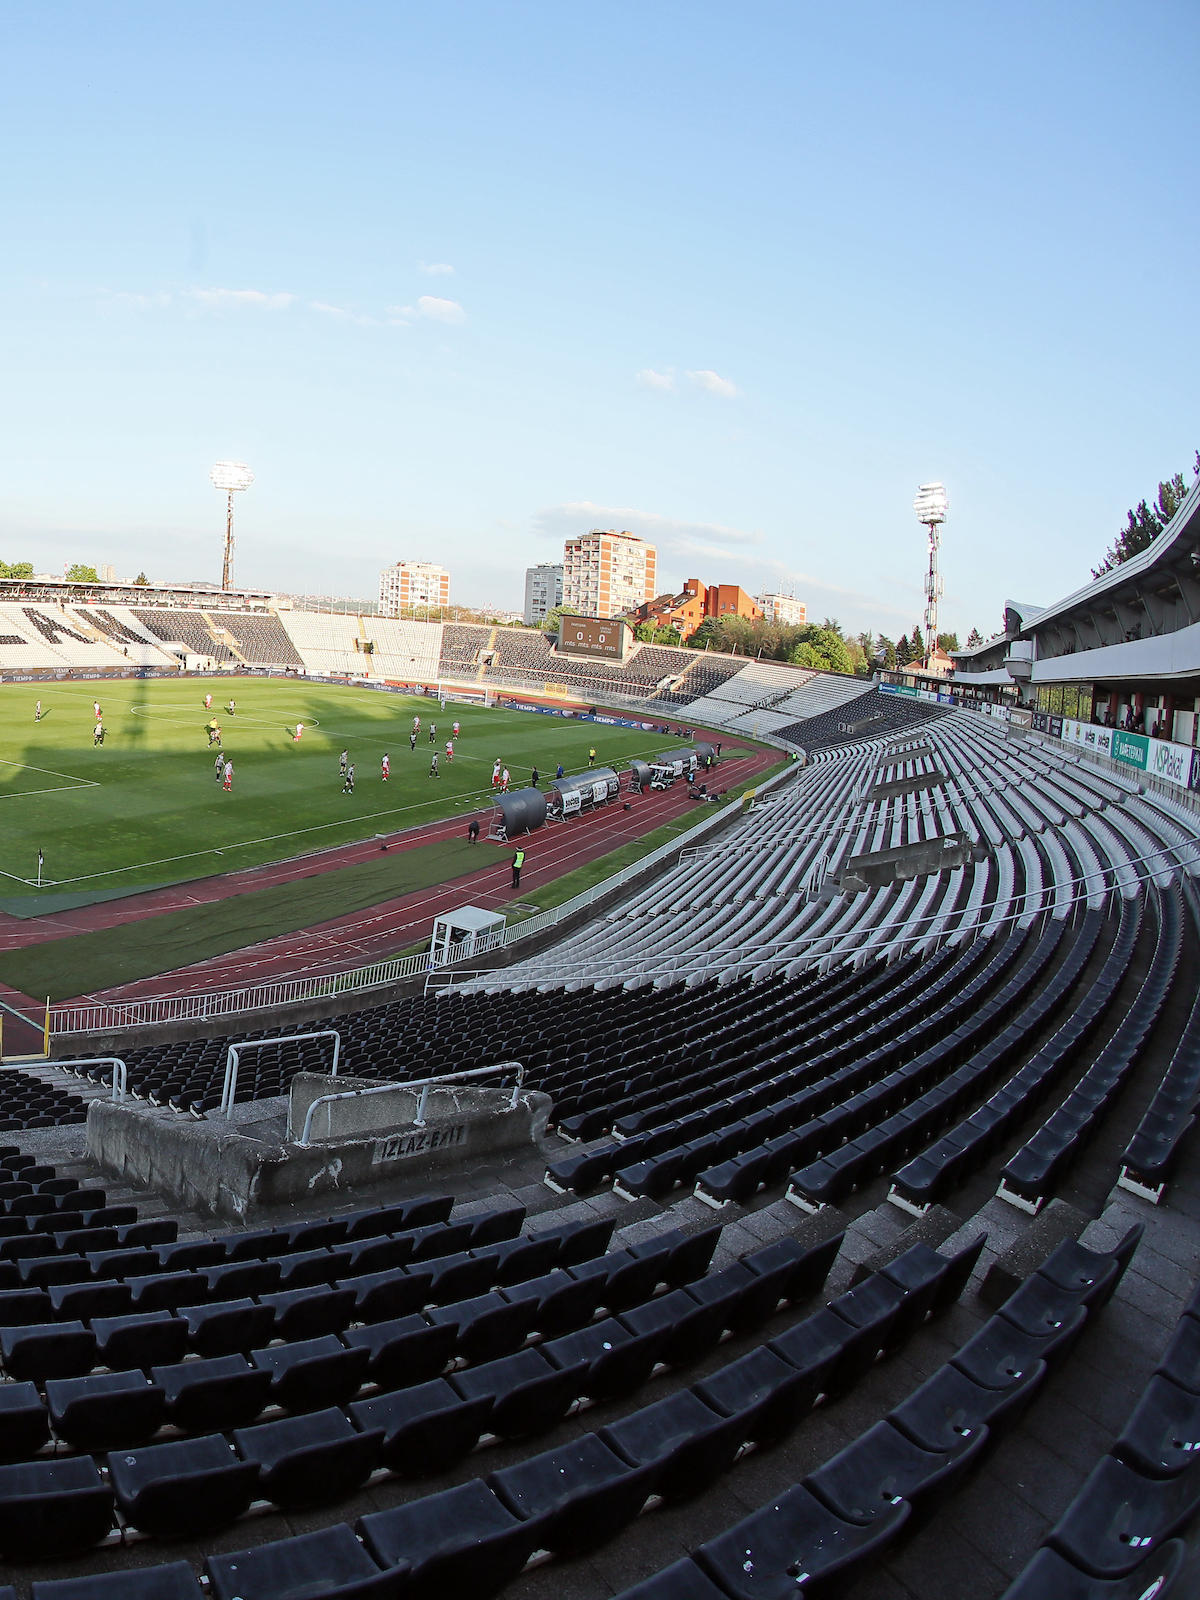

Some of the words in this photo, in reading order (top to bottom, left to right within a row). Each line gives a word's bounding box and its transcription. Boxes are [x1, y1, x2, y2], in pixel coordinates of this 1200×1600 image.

[576, 631, 584, 641] 0
[598, 634, 606, 643] 0
[515, 703, 539, 712] TIEMPO
[593, 716, 617, 725] TIEMPO
